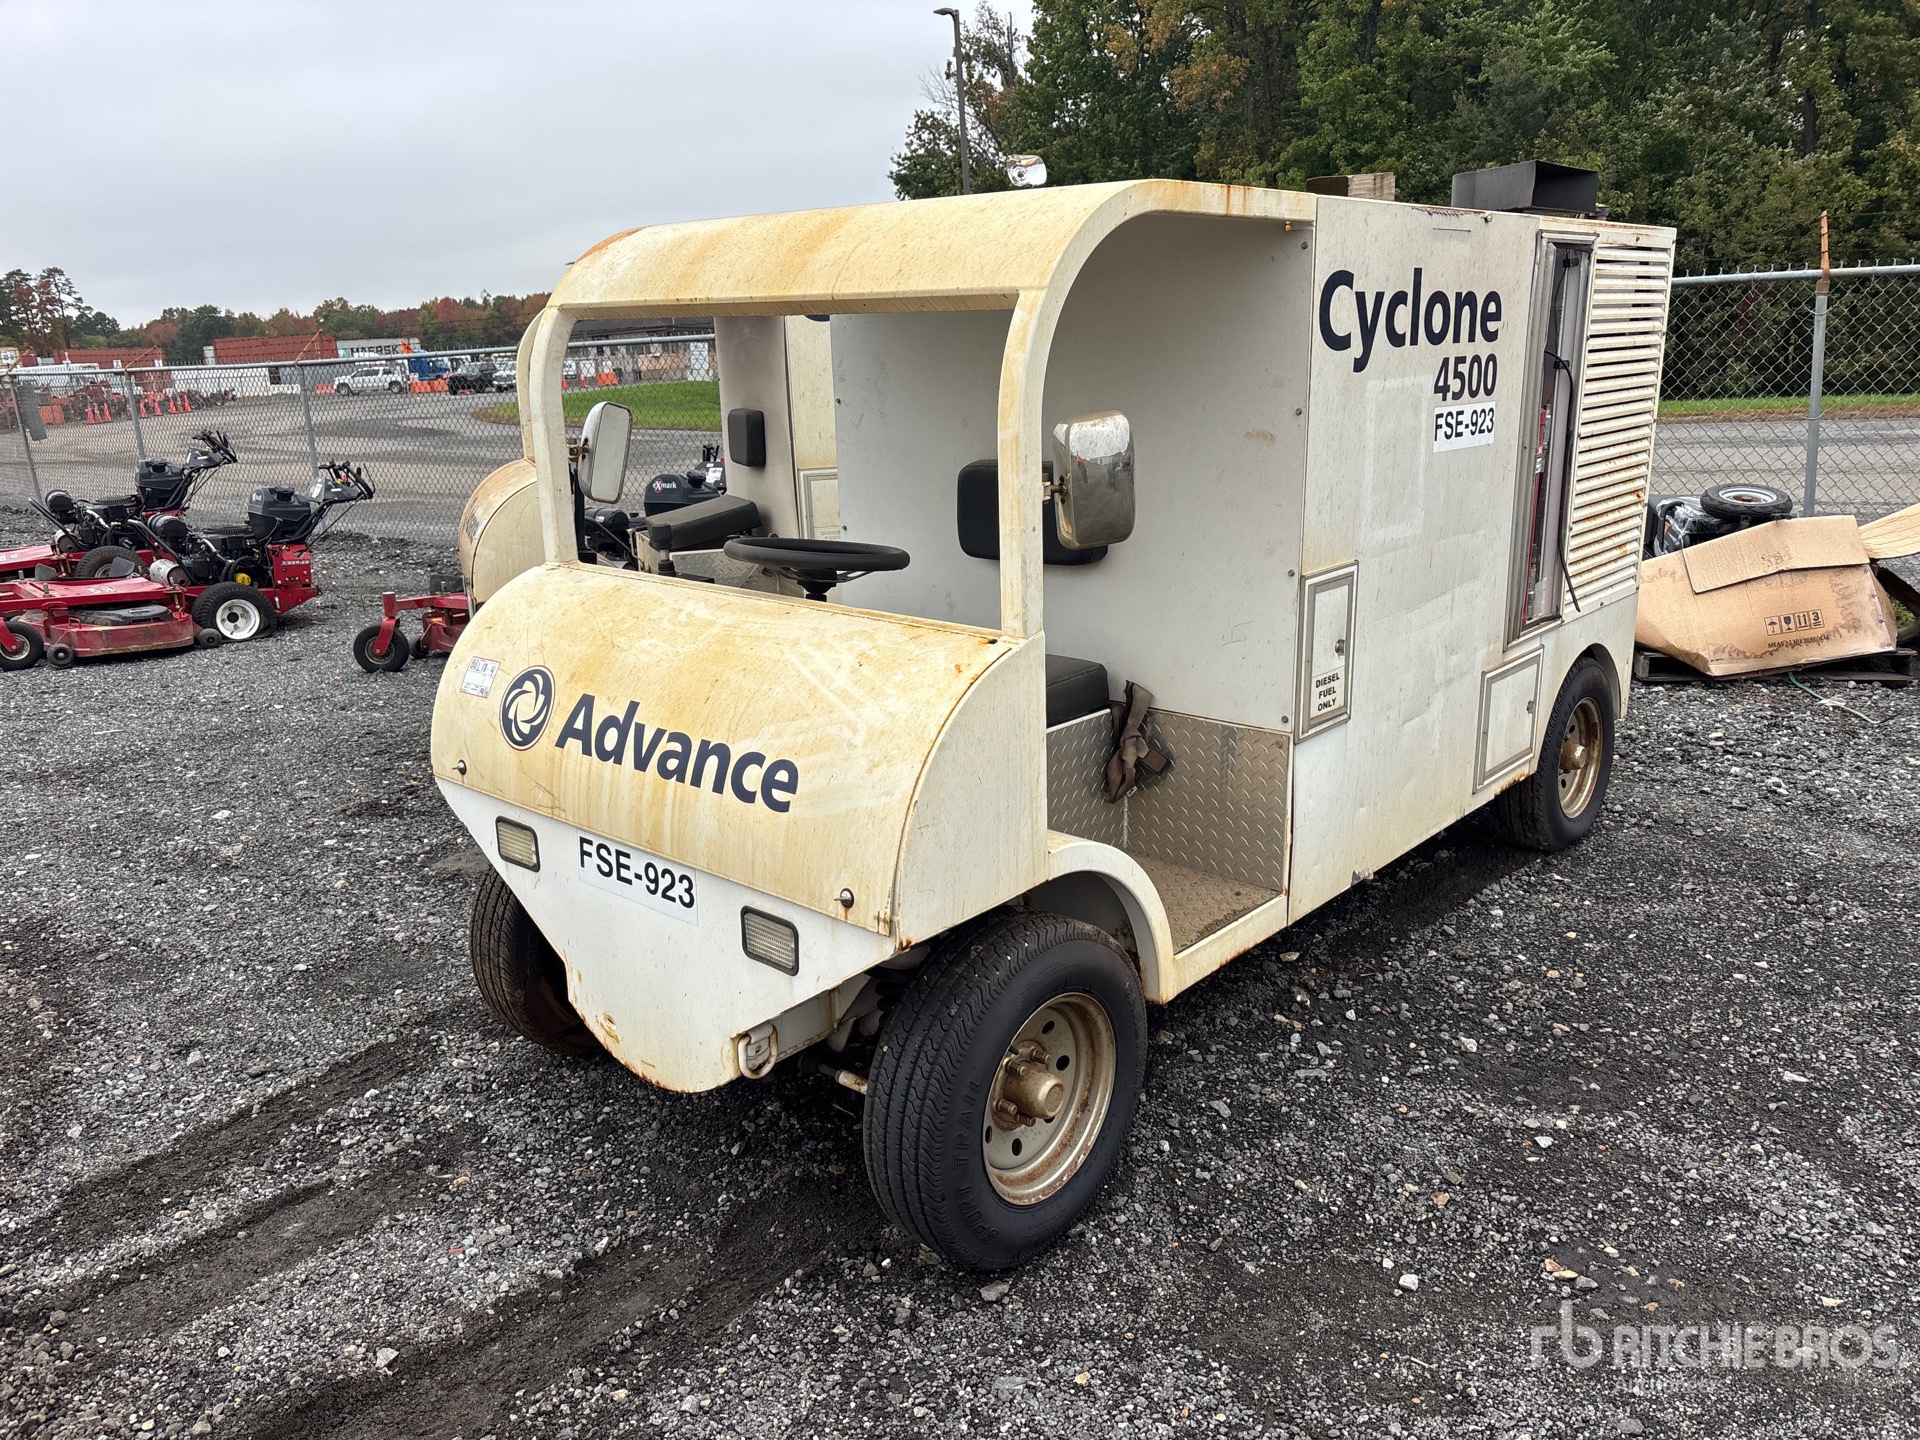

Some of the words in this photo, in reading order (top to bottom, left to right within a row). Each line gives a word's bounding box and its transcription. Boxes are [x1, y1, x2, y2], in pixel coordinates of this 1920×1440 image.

[1319, 267, 1502, 373] Cyclone
[1433, 353, 1497, 401] 4500
[1434, 407, 1495, 442] FSE-923
[652, 481, 677, 490] eXmark
[1316, 673, 1340, 688] DIESEL
[1318, 686, 1336, 699] FUEL
[1317, 697, 1336, 711] ONLY
[554, 693, 799, 813] Advance
[579, 835, 695, 909] FSE-923
